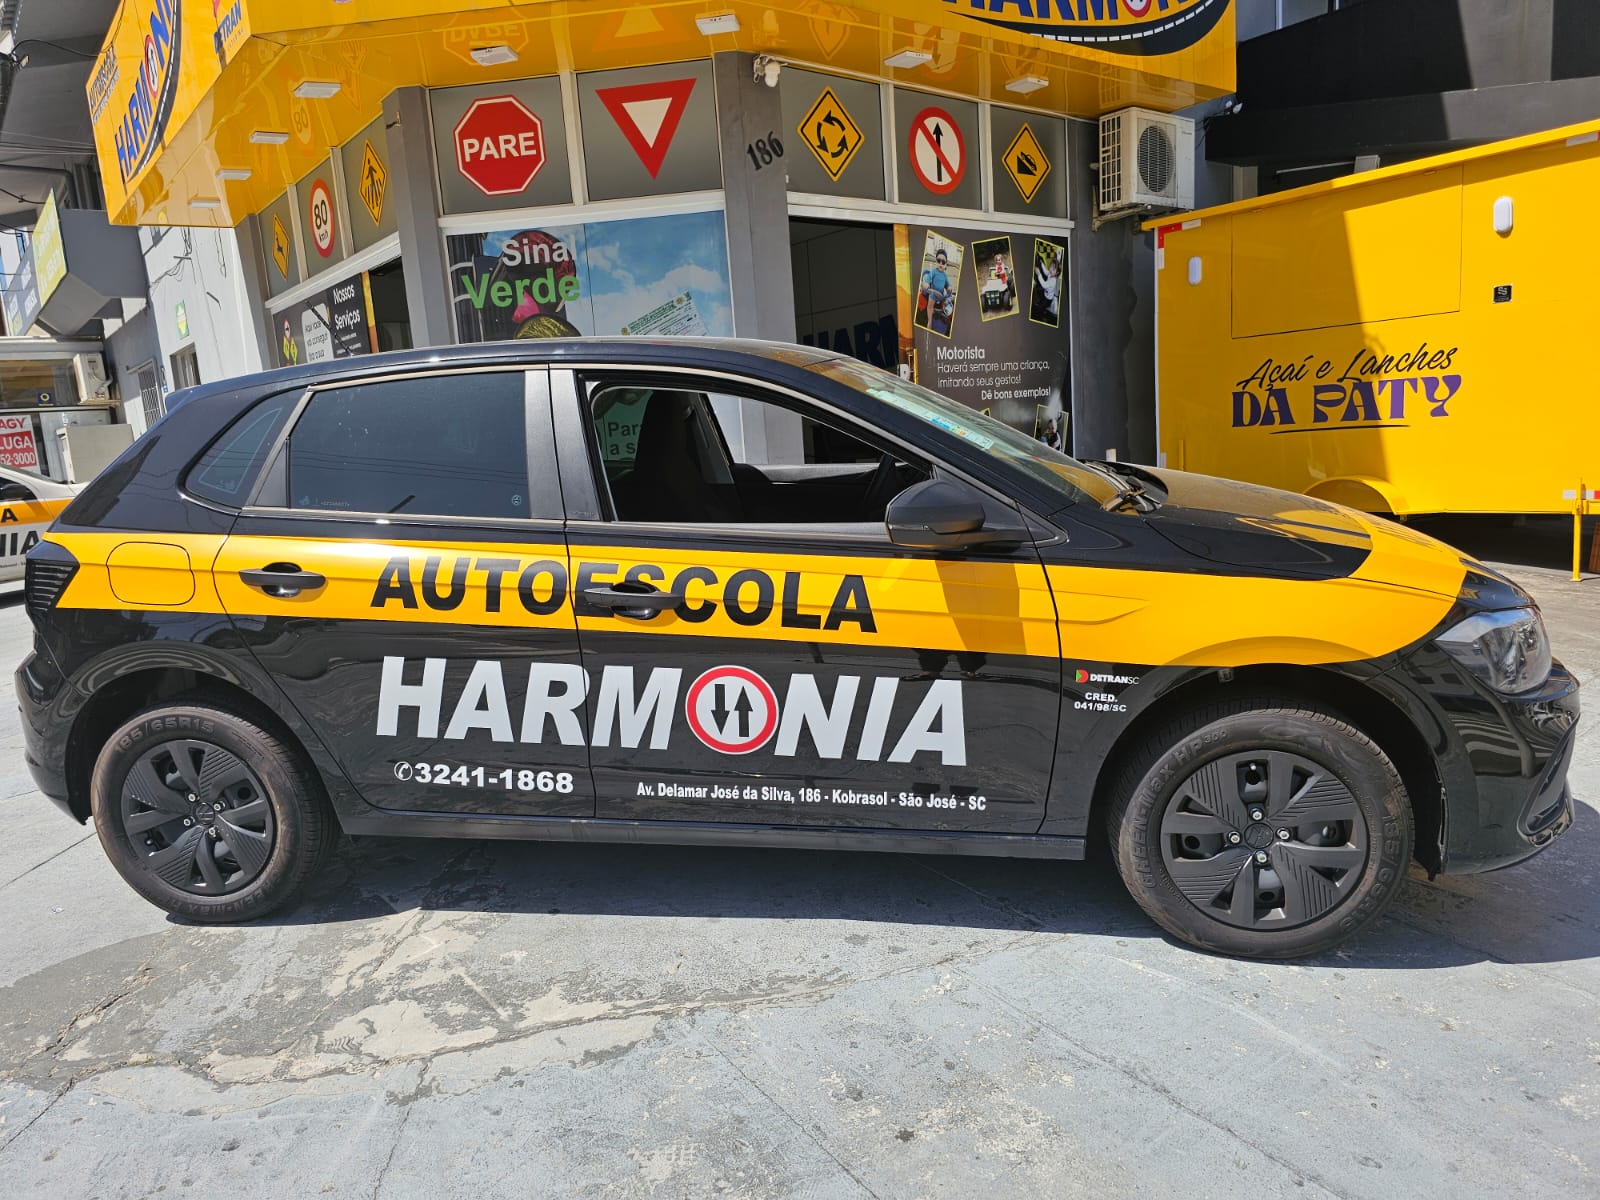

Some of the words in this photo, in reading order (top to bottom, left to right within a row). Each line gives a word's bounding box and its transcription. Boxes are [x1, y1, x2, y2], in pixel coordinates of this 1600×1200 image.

[463, 131, 537, 162] PARE
[747, 130, 784, 171] 186
[314, 200, 327, 230] 80
[502, 234, 576, 267] Sinal
[333, 284, 355, 304] Nossos
[461, 268, 580, 309] Verde
[334, 309, 360, 330] Serviços
[937, 346, 985, 360] Motorista
[937, 361, 967, 373] Haverá
[969, 362, 999, 373] sempre
[1001, 363, 1018, 371] uma
[1020, 360, 1050, 371] criança,
[1236, 355, 1314, 391] Açaí
[1316, 360, 1334, 379] e
[1337, 342, 1458, 385] Lanches
[976, 378, 993, 386] seus
[995, 374, 1021, 387] gestos!
[981, 390, 993, 400] Dê
[994, 389, 1012, 400] bons
[1014, 386, 1051, 399] exemplos!
[1232, 388, 1295, 427] DA
[1313, 374, 1462, 424] PATY
[608, 422, 641, 437] Par
[1074, 701, 1127, 712] 041/98/SC
[1085, 692, 1118, 702] CRED.
[415, 762, 574, 793] 3241-1868
[637, 782, 654, 796] Av.
[658, 783, 708, 799] Delamar
[711, 785, 740, 799] José
[743, 786, 757, 800] da
[761, 786, 794, 804] Silva,
[799, 787, 821, 802] 186
[832, 789, 888, 806] Kobrasol
[899, 792, 923, 807] São
[926, 794, 957, 809] José
[968, 796, 987, 811] SC
